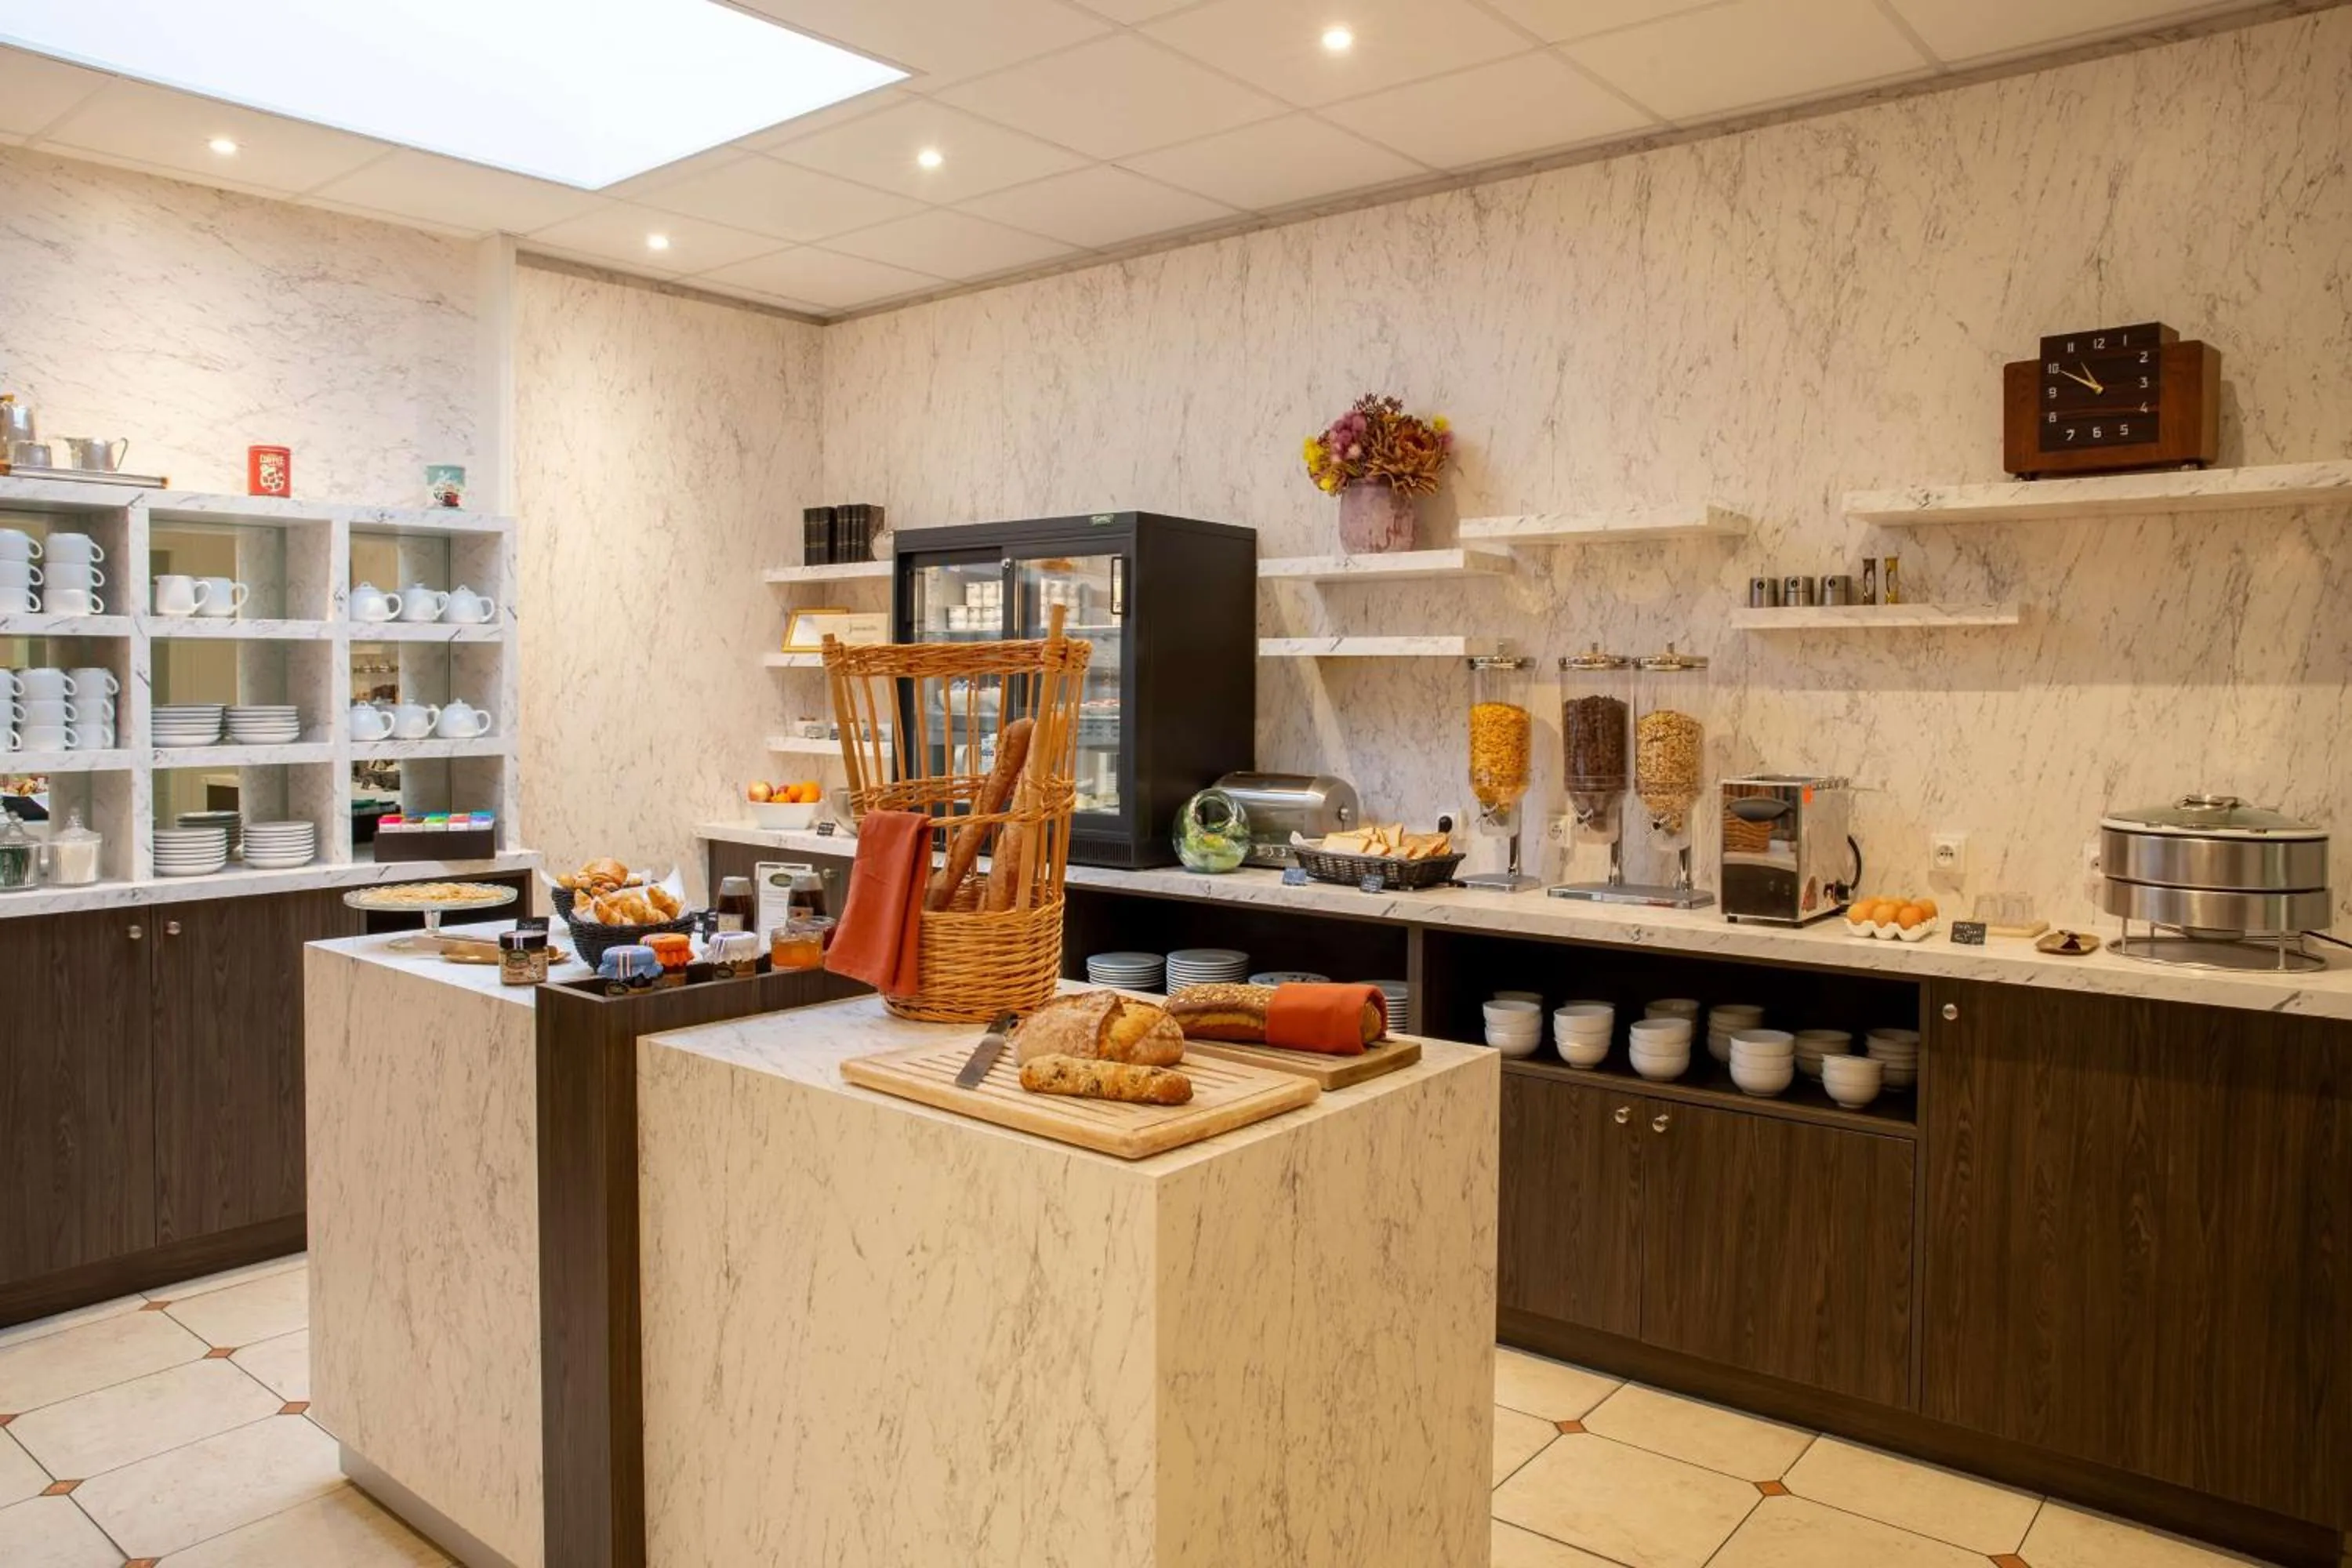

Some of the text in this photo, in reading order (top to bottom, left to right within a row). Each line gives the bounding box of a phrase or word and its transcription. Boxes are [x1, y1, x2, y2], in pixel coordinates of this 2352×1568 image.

[2093, 338, 2105, 350] 12
[2122, 334, 2127, 346] 1
[2067, 342, 2074, 353] 11
[2139, 350, 2148, 363] 2
[2048, 363, 2060, 374] 10
[2140, 376, 2148, 388] 3
[2049, 387, 2057, 398] 9
[2140, 401, 2148, 413] 4
[2049, 412, 2057, 423] 8
[2066, 429, 2075, 441] 7
[2092, 426, 2102, 438] 6
[2119, 423, 2129, 436] 5
